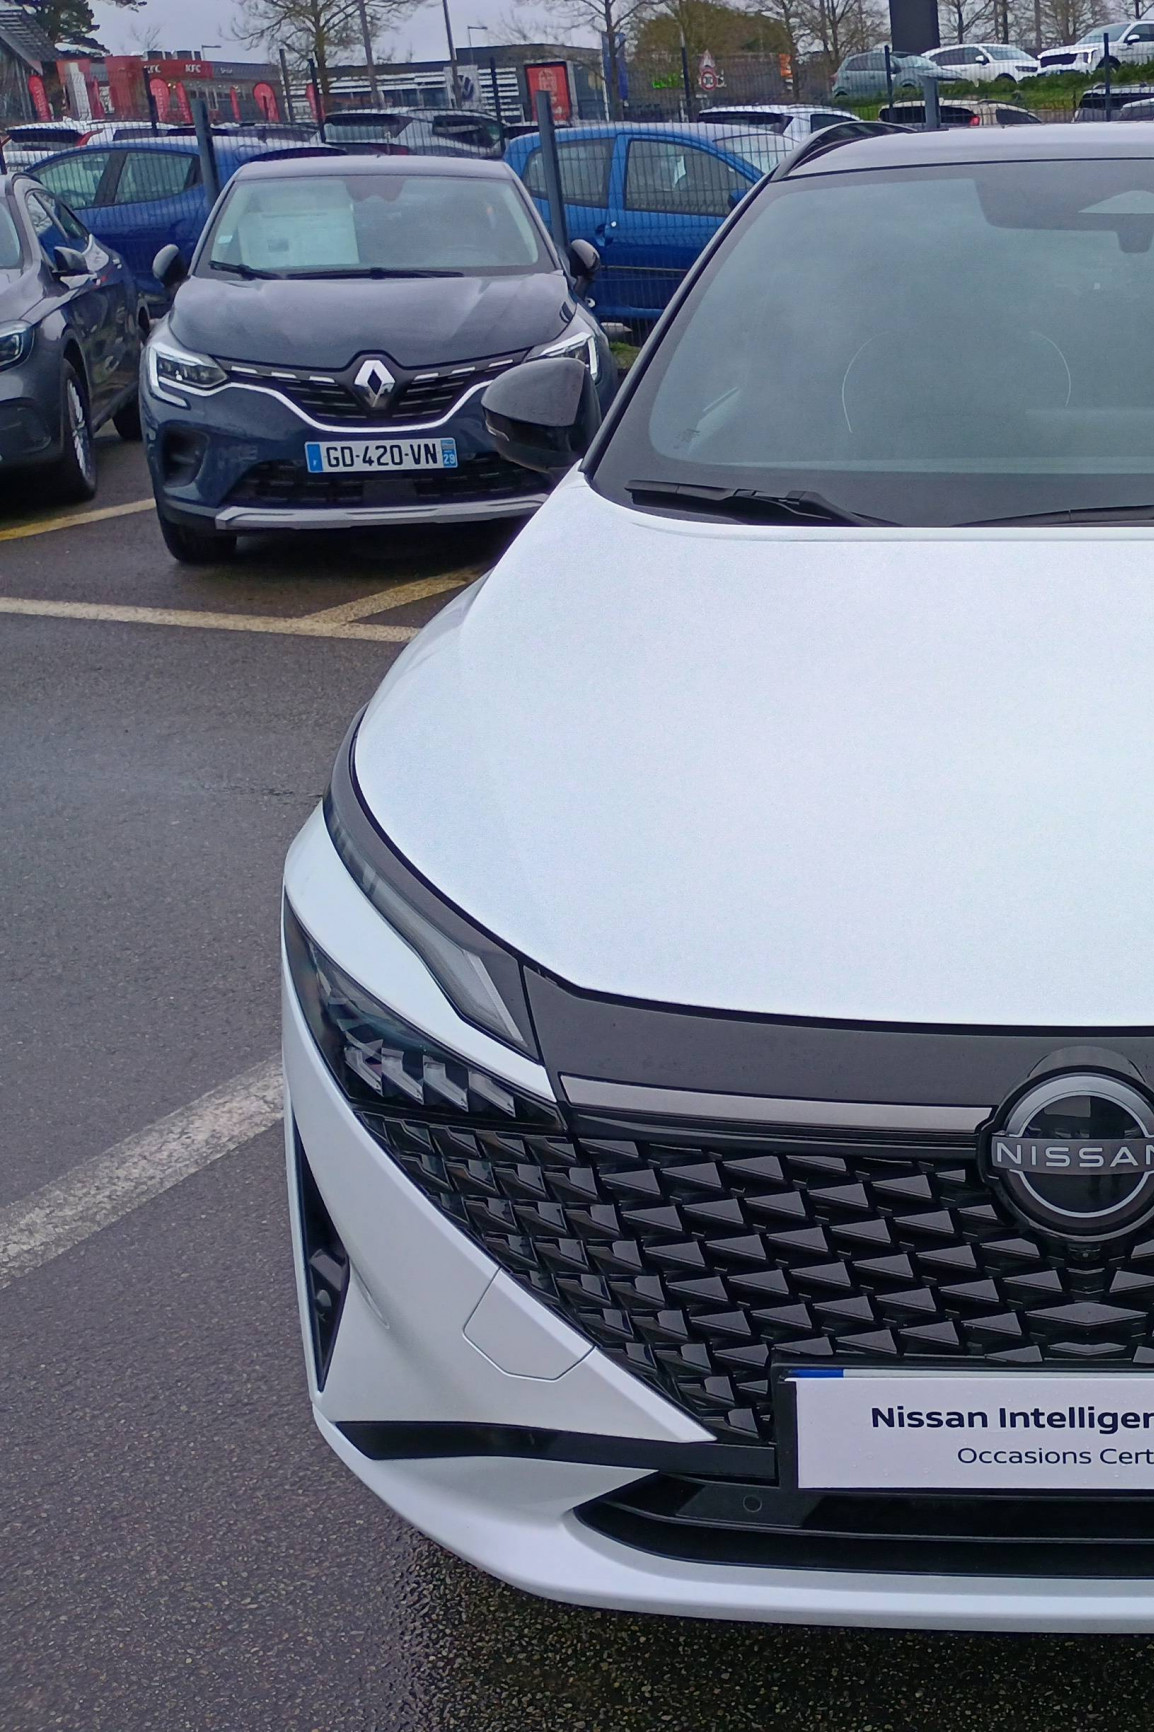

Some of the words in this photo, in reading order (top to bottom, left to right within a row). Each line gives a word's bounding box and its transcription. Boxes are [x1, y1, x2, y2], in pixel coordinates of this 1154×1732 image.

[185, 64, 201, 73] KFC
[326, 443, 438, 468] GD-420-VN
[871, 1406, 989, 1429] Nissan
[957, 1447, 1092, 1465] Occasions
